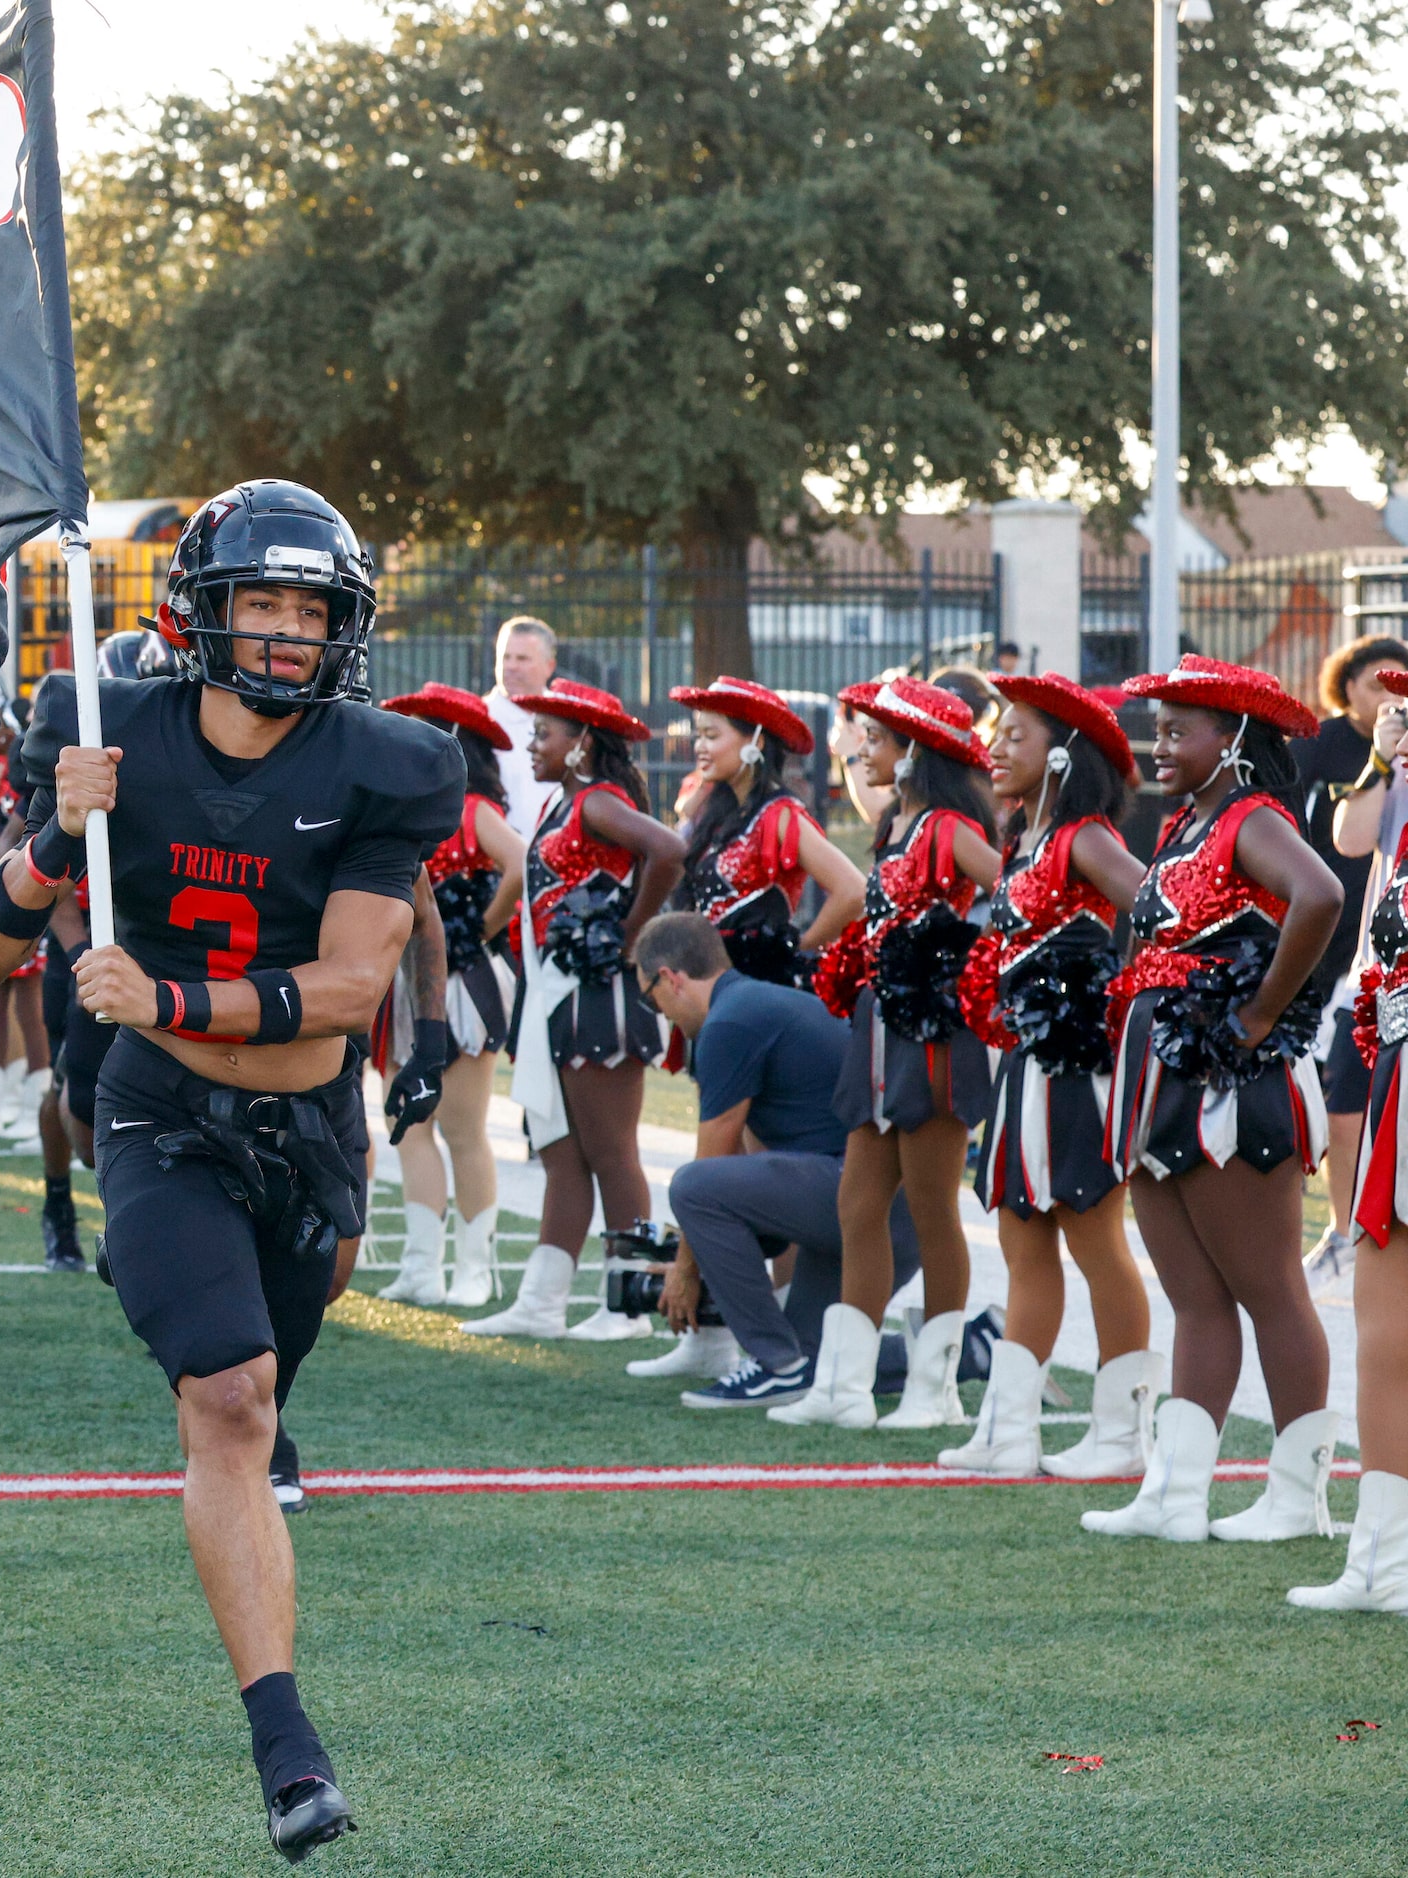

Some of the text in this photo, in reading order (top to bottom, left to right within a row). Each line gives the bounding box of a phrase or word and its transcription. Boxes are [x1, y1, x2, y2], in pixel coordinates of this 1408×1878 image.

[169, 842, 272, 889] TRINITY
[168, 884, 260, 1045] 3
[176, 993, 184, 1016] FAMILY
